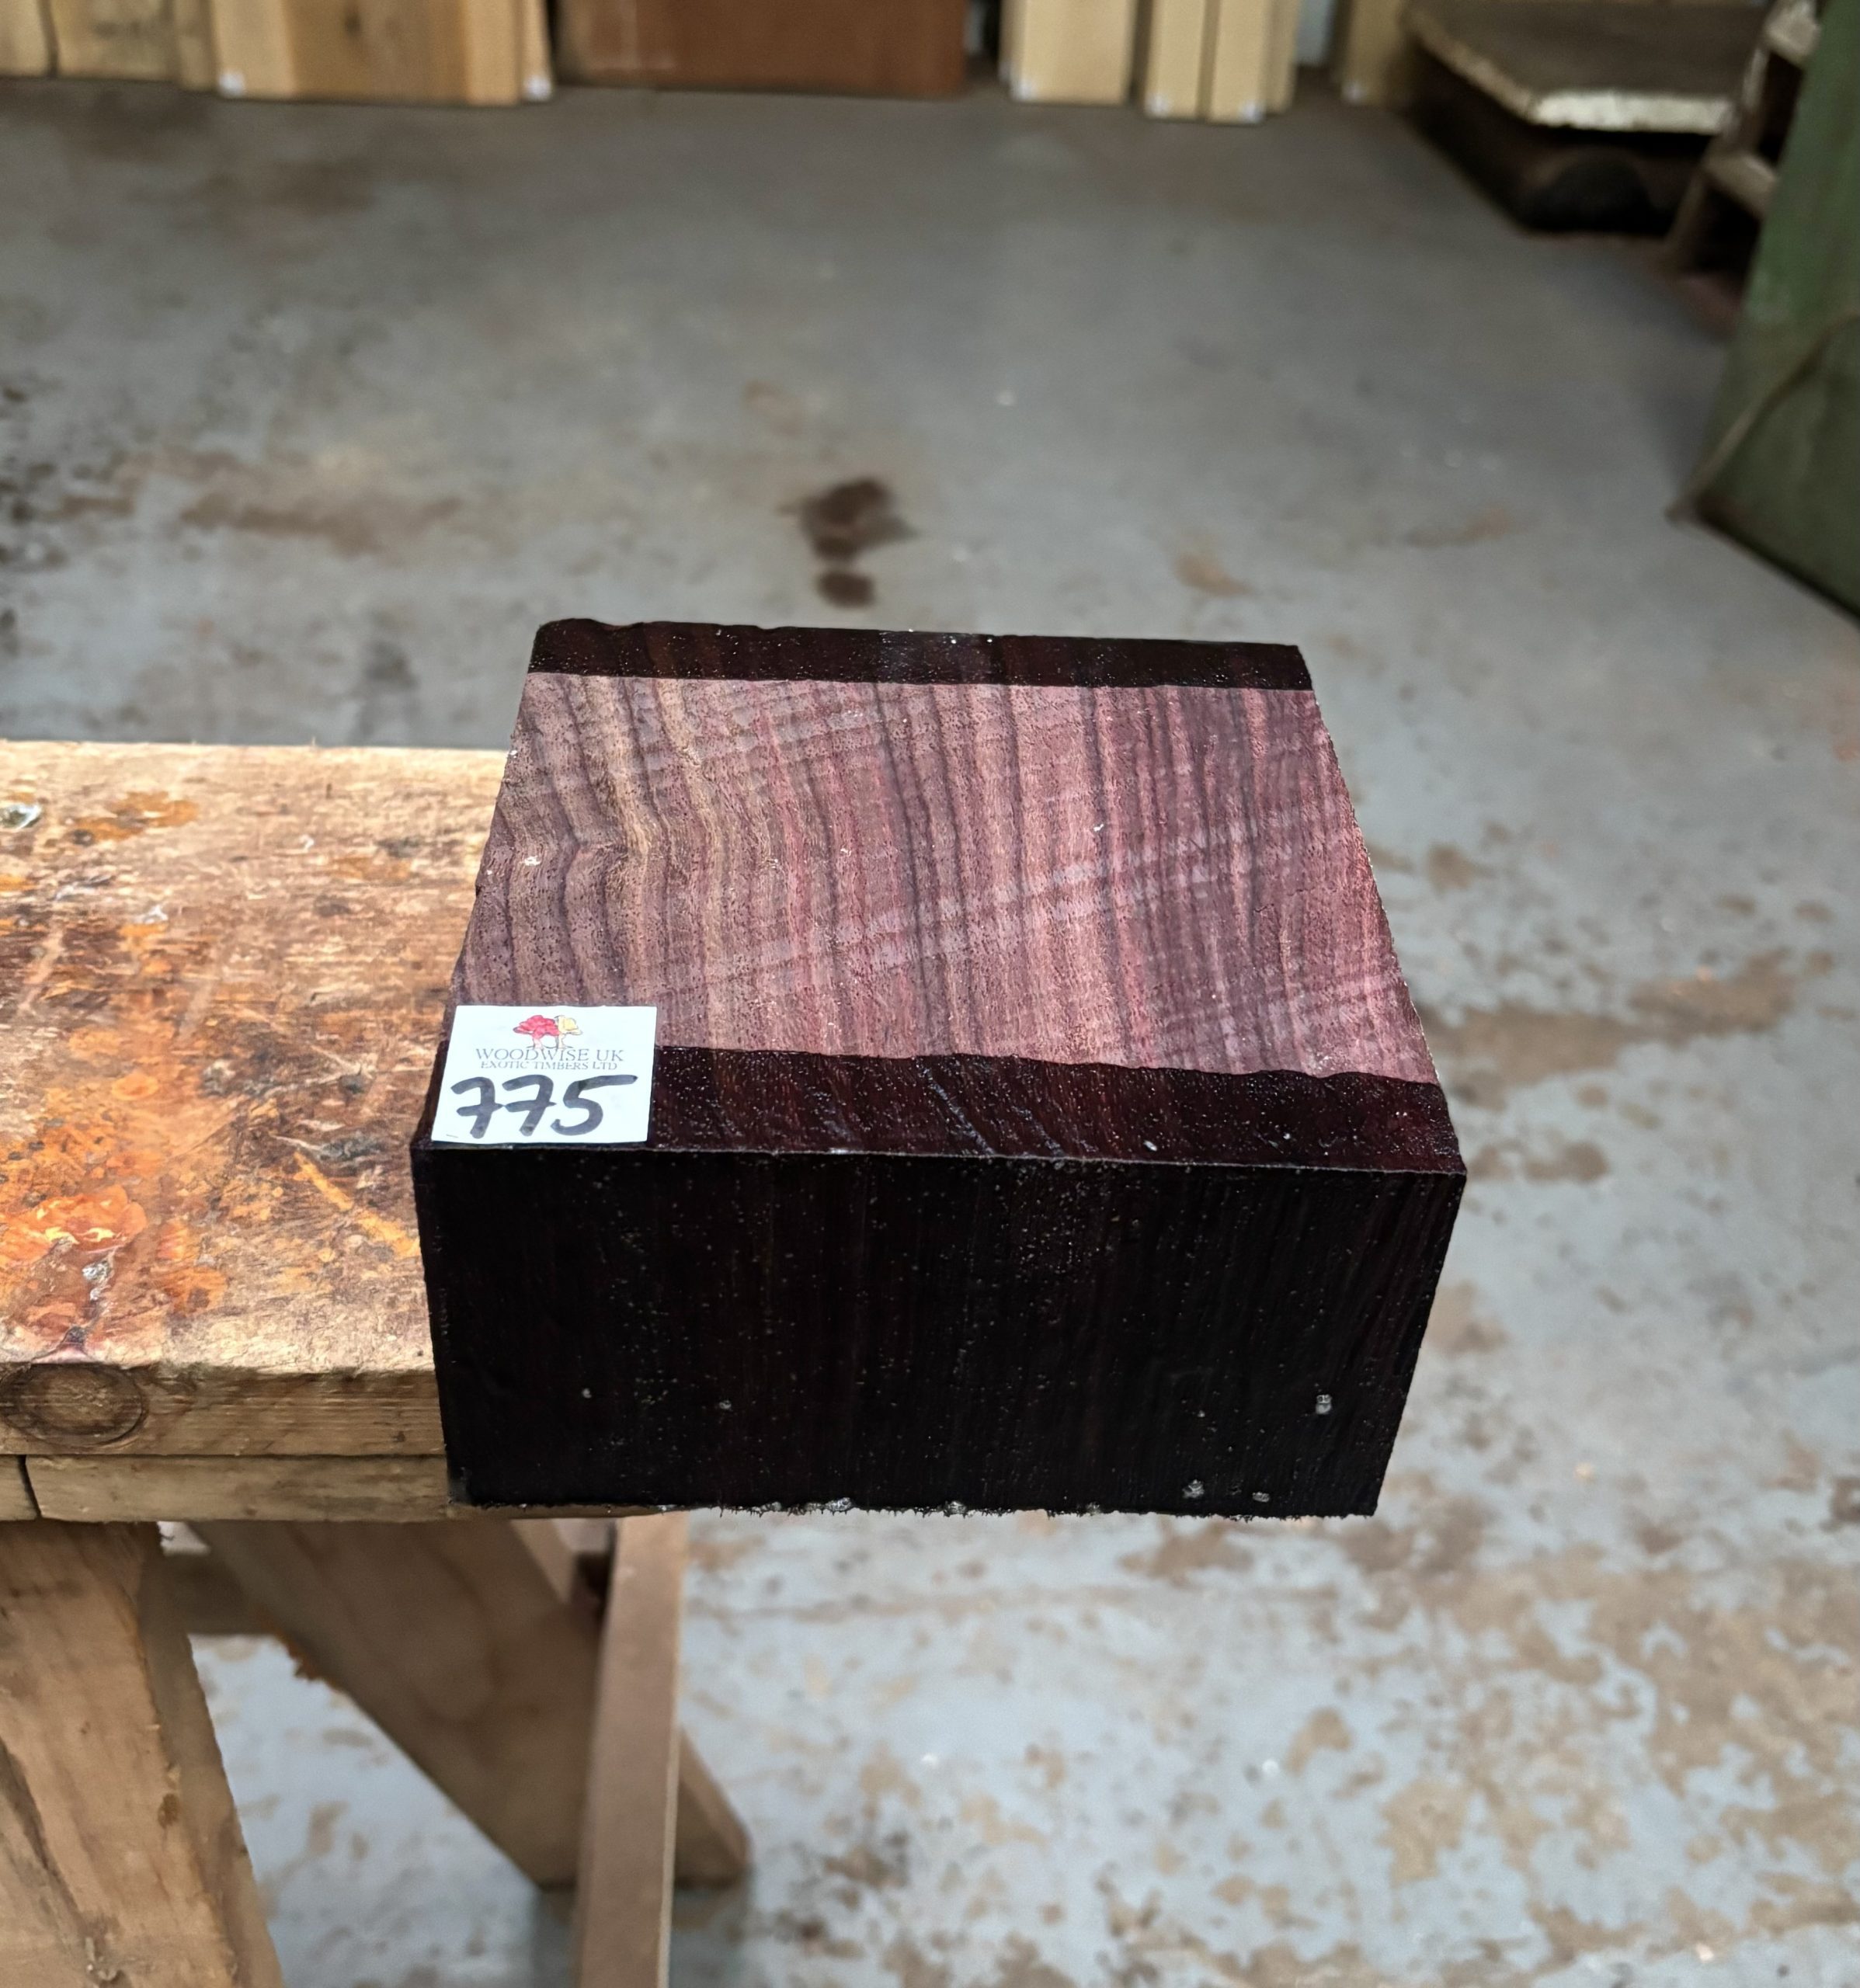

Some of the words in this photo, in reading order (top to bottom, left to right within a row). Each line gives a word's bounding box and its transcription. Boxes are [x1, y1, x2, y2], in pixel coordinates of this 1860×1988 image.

[475, 1048, 589, 1062] WOODWISE
[596, 1049, 624, 1062] UK
[480, 1061, 529, 1069] EXOTIC
[534, 1061, 589, 1071] TIMBERS
[592, 1061, 618, 1071] LTD
[450, 1074, 638, 1139] 775
